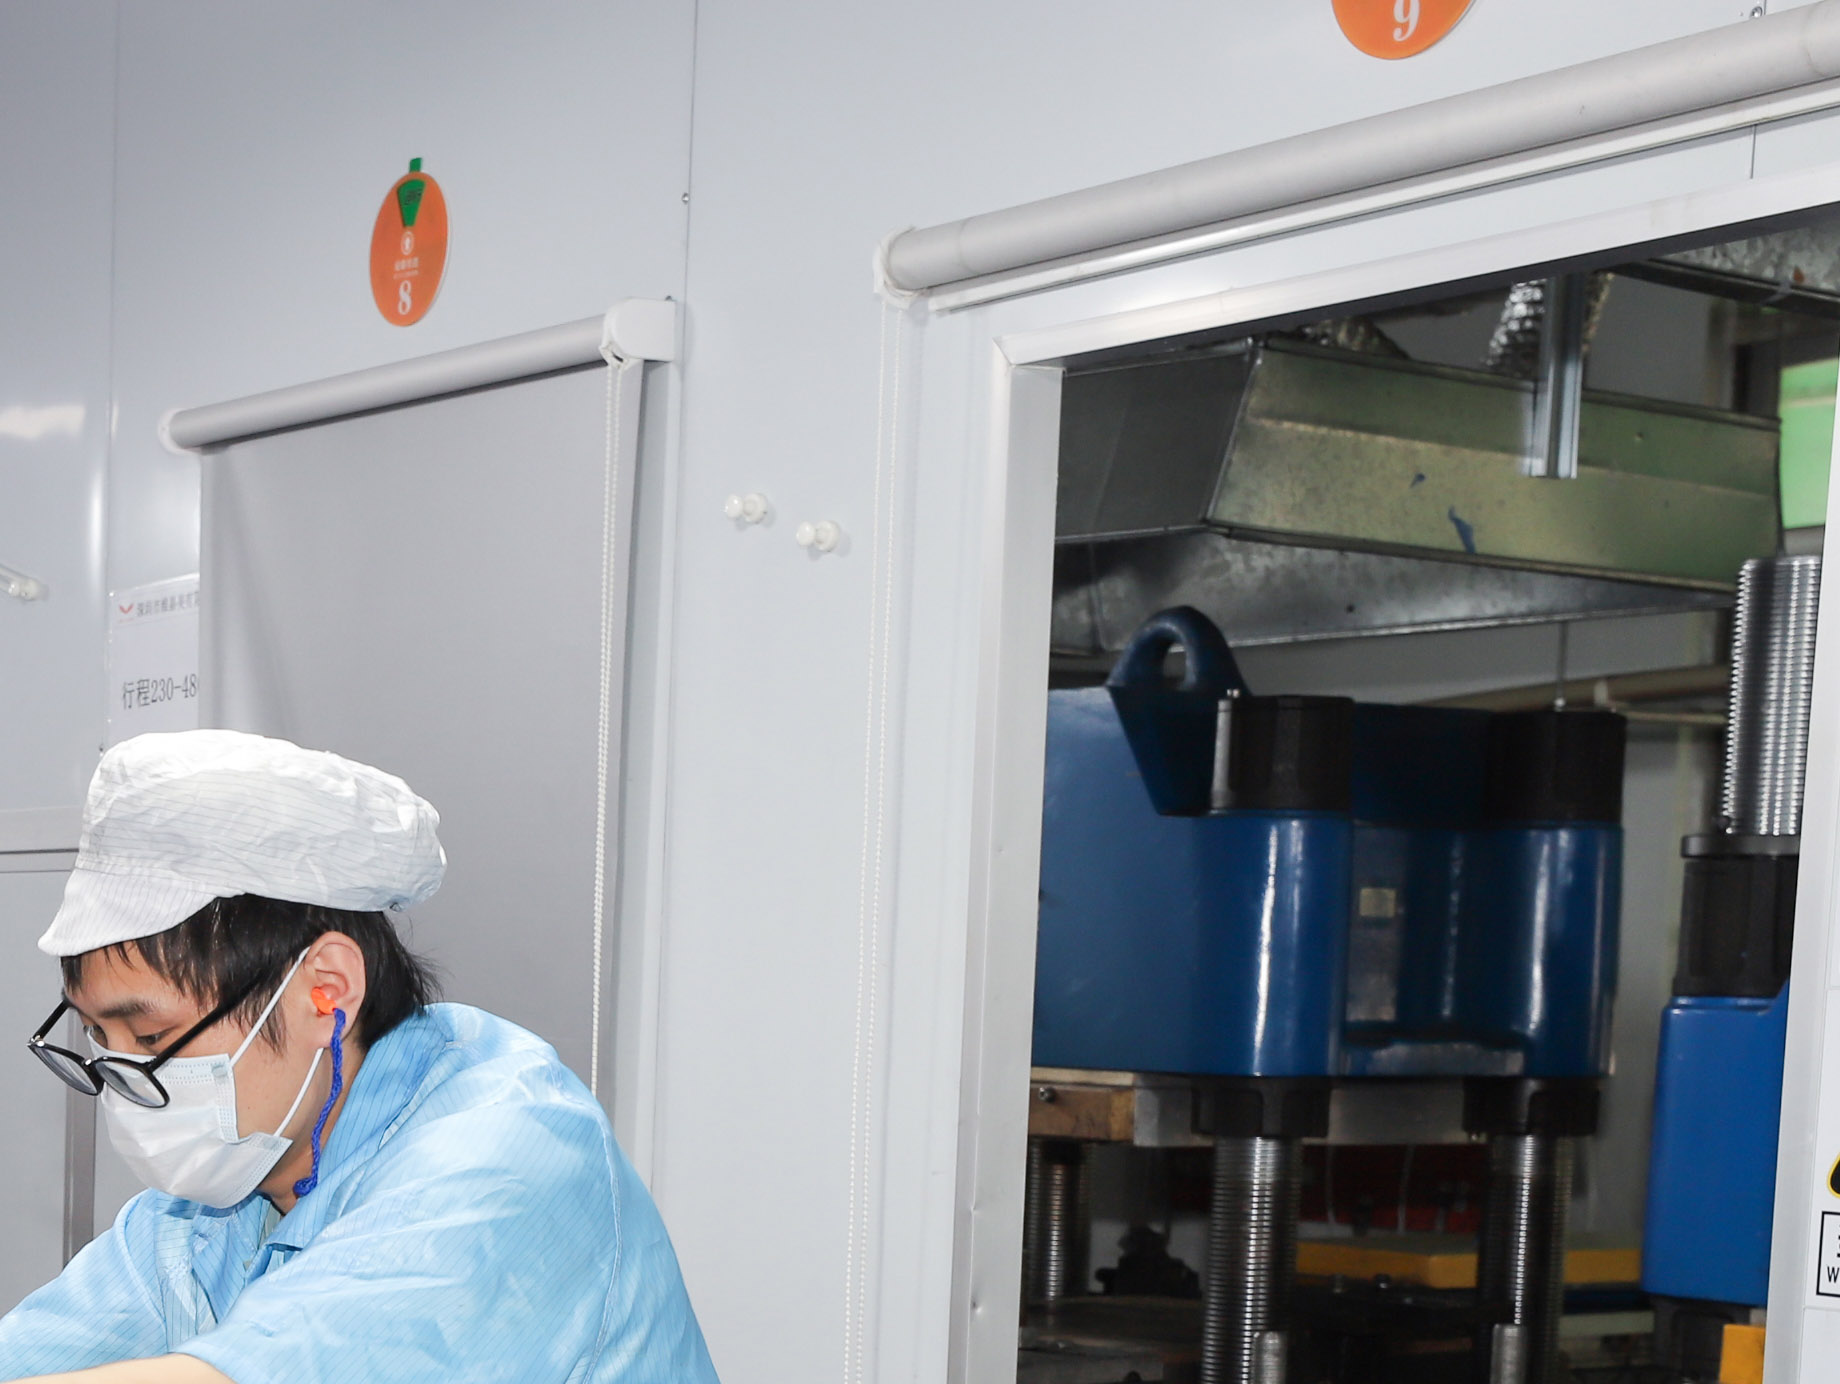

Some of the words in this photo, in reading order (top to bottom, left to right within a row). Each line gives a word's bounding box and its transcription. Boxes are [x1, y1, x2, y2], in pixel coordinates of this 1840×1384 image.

[1393, 0, 1420, 42] 9
[397, 279, 412, 315] 8
[122, 673, 199, 710] 行程230-48
